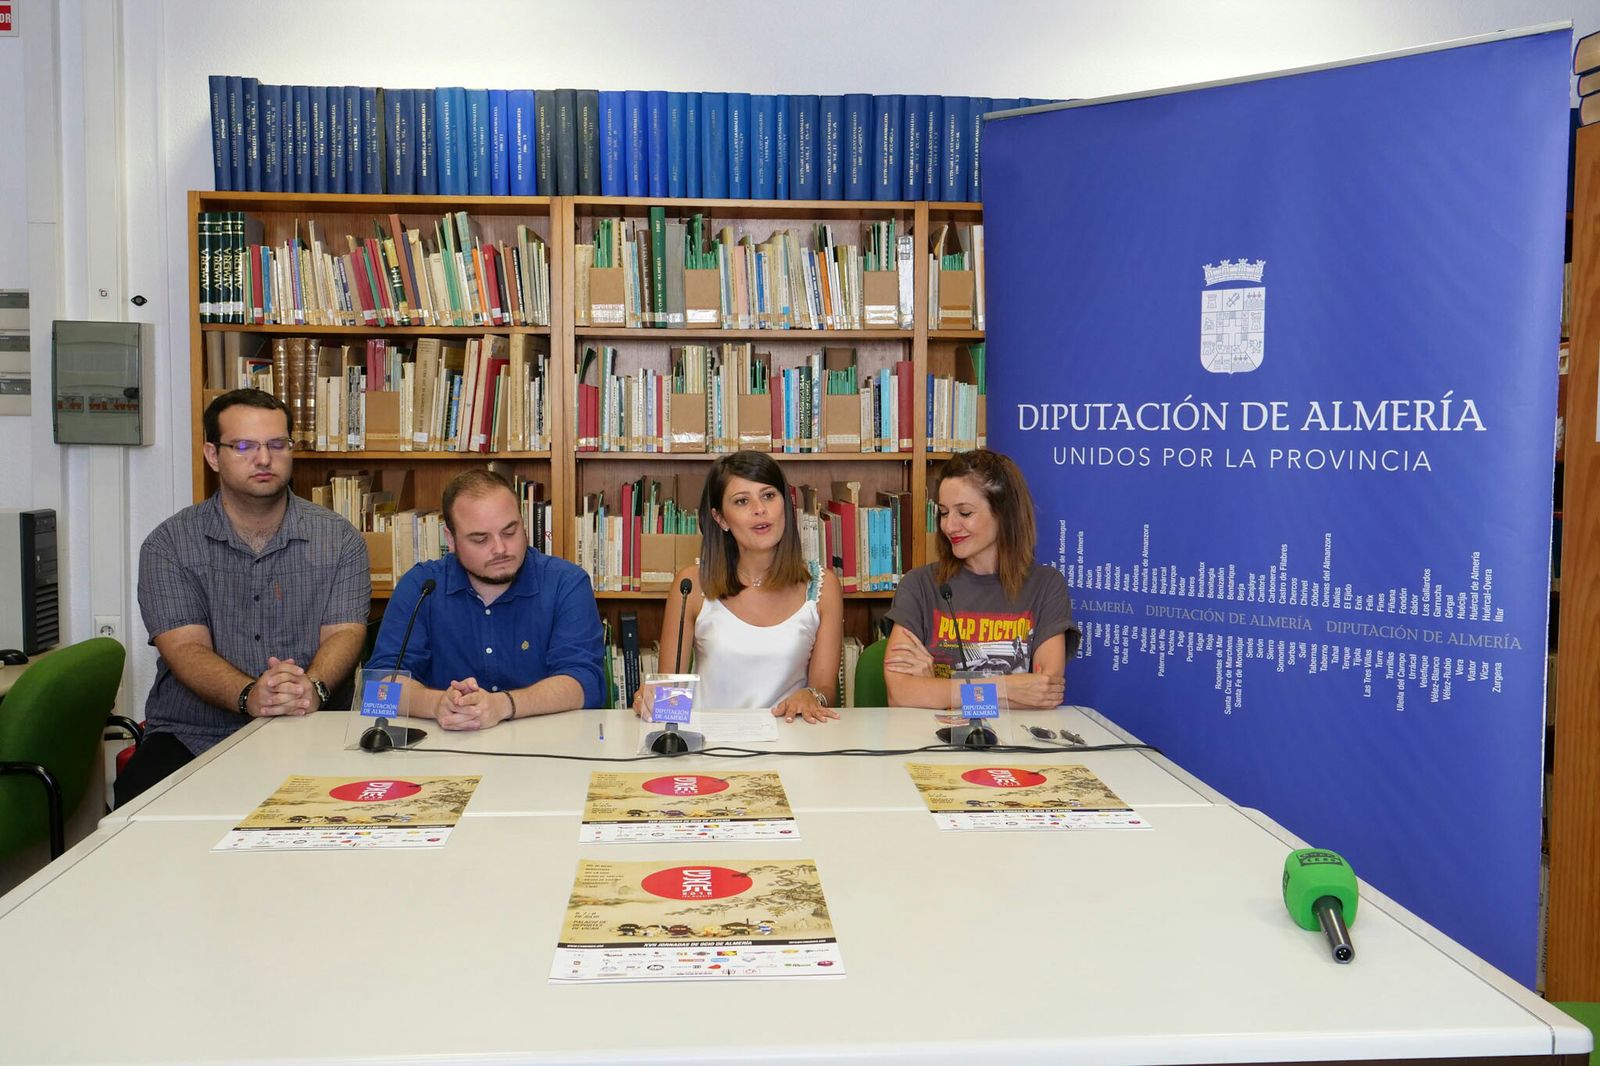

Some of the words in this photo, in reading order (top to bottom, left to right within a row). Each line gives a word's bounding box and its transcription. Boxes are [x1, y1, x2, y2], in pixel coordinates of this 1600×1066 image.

[1017, 395, 1228, 432] DIPUTACIÓN
[1241, 401, 1290, 432] DE
[1300, 389, 1487, 432] ALMERÍA
[1053, 446, 1151, 467] UNIDOS
[1162, 447, 1213, 468] POR
[1225, 449, 1257, 470] LA
[1270, 449, 1432, 472] PROVINCIA
[1059, 520, 1067, 554] Monteagud
[1059, 555, 1066, 563] de
[1077, 556, 1084, 564] de
[1142, 559, 1149, 567] de
[1279, 544, 1288, 571] Filabres
[1323, 533, 1332, 570] Almanzora
[1168, 565, 1178, 595] Bayarque
[1188, 576, 1196, 597] Beires
[1197, 562, 1205, 598] Benahadux
[1206, 568, 1216, 598] Benitagla
[1217, 568, 1225, 599] Benizalón
[1226, 564, 1236, 600] Bentarique
[1268, 565, 1277, 603] Carboneras
[1279, 572, 1287, 581] de
[1322, 570, 1330, 581] del
[1421, 568, 1431, 602] Gallardos
[1470, 581, 1479, 591] de
[1236, 583, 1246, 601] Berja
[1257, 574, 1266, 602] Cantoria
[1278, 582, 1287, 604] Castro
[1289, 577, 1298, 605] Chercos
[1300, 580, 1308, 606] Chirivel
[1311, 582, 1319, 606] Cóbdar
[1321, 583, 1330, 608] Cuevas
[1344, 584, 1353, 601] Ejido
[1482, 569, 1492, 621] Huércal-Overa
[1071, 599, 1079, 610] E
[1080, 600, 1135, 614] ALMERÍA
[1354, 595, 1363, 610] Enix
[1365, 595, 1374, 611] Felix
[1376, 593, 1385, 612] Fines
[1387, 589, 1396, 613] Fiñana
[1399, 588, 1408, 614] Fondón
[1409, 594, 1419, 615] Gádor
[1422, 603, 1430, 616] Los
[1433, 584, 1442, 617] Garrucha
[1445, 594, 1455, 618] Gérgal
[1457, 592, 1467, 619] Huécija
[1469, 592, 1479, 620] Huércal
[938, 615, 976, 640] PULP
[1146, 604, 1225, 623] DIPUTACIÓN
[1228, 612, 1247, 625] DE
[1250, 614, 1313, 631] ALMERÍA
[1196, 632, 1205, 651] Rágol
[1206, 634, 1215, 650] Rioja
[1326, 620, 1419, 641] DIPUTACIÓN
[1423, 630, 1443, 644] DE
[1447, 632, 1522, 650] ALMERÍA
[1113, 646, 1120, 654] de
[1186, 632, 1194, 662] Purchena
[1215, 649, 1223, 658] de
[1225, 636, 1233, 668] Marchena
[1235, 637, 1245, 668] Mondújar
[1245, 638, 1254, 658] Senés
[1256, 638, 1264, 658] Serón
[1266, 640, 1275, 660] Sierro
[1287, 642, 1296, 665] Sorbas
[1319, 645, 1328, 672] Taberno
[1331, 646, 1339, 664] Tahal
[1342, 647, 1352, 670] Terque
[1364, 649, 1372, 668] Villas
[1309, 644, 1318, 674] Tabernas
[1375, 650, 1384, 668] Turre
[1385, 652, 1395, 679] Turrillas
[1397, 652, 1407, 677] Campo
[1455, 659, 1464, 675] Vera
[1215, 659, 1223, 689] Roquetas
[1225, 669, 1233, 678] de
[1235, 669, 1243, 678] de
[1363, 669, 1372, 683] Tres
[1430, 656, 1440, 702] Vélez-Blanco
[1442, 658, 1452, 700] Vélez-Rubio
[1467, 660, 1476, 682] Viator
[1492, 662, 1503, 693] Zurgena
[1224, 679, 1232, 694] Cruz
[1234, 679, 1242, 688] Fe
[1363, 684, 1372, 697] Las
[1397, 678, 1405, 690] del
[1224, 696, 1232, 715] Santa
[1234, 688, 1242, 708] Santa
[1396, 691, 1405, 711] Uleila
